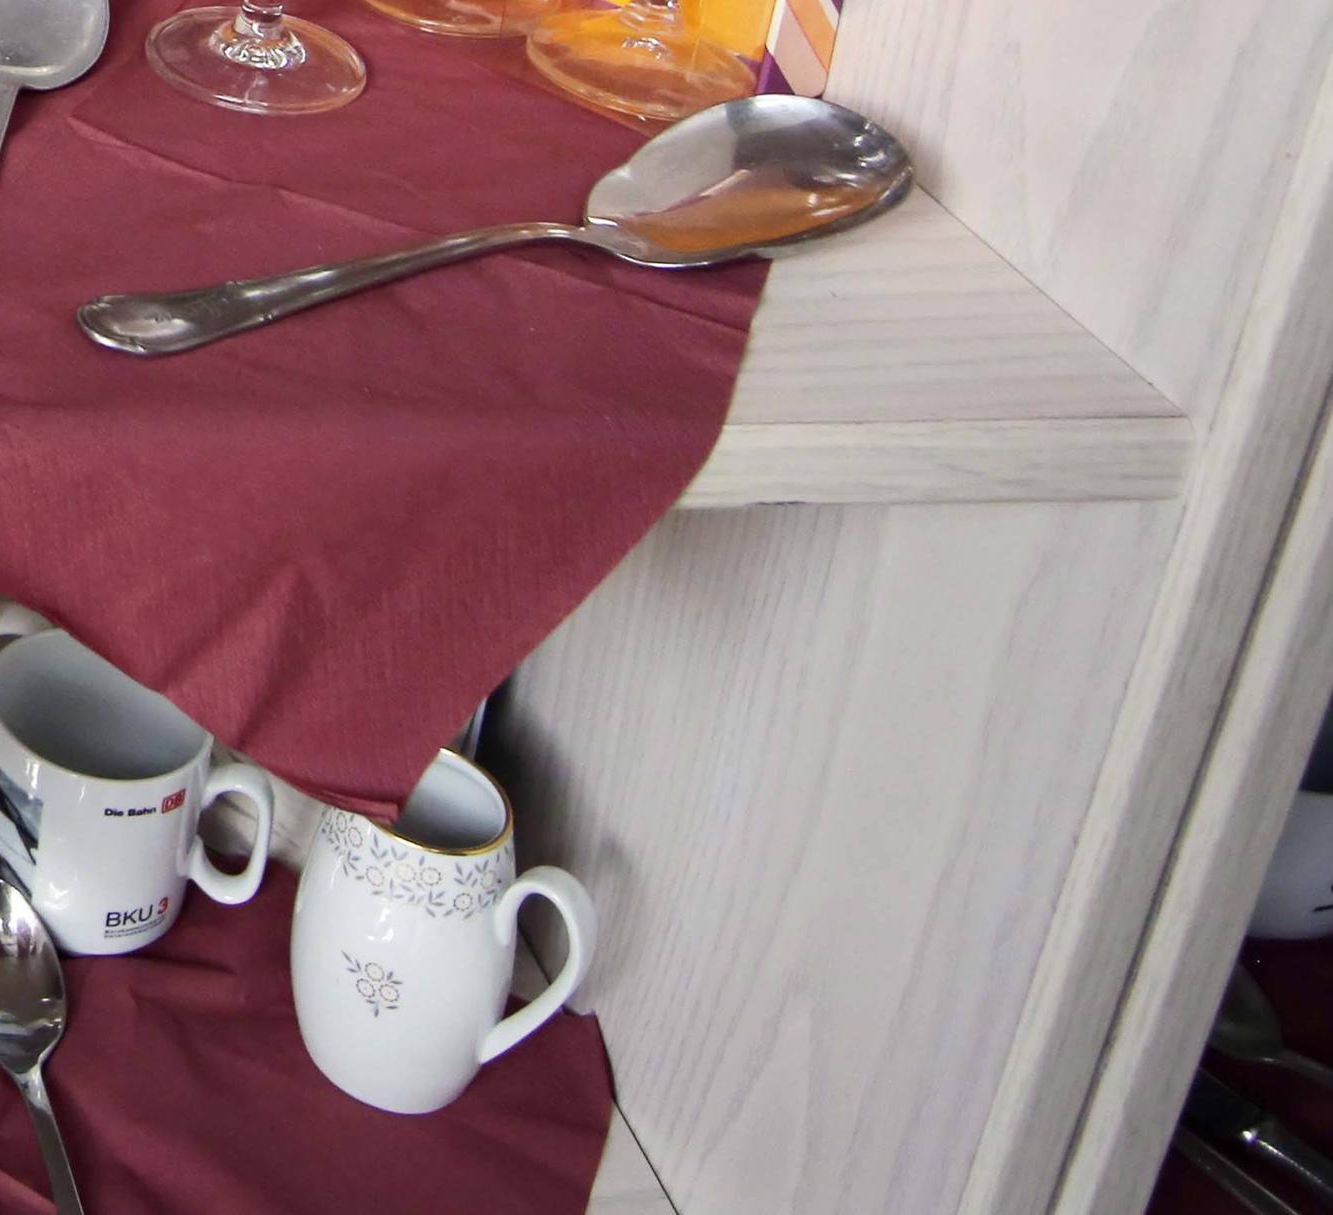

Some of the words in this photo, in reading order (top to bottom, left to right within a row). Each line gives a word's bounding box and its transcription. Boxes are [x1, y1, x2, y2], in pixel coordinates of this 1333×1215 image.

[104, 808, 124, 817] Die
[127, 807, 157, 817] Bahn
[162, 790, 185, 813] DB
[105, 904, 154, 927] BKU
[157, 897, 169, 915] 3
